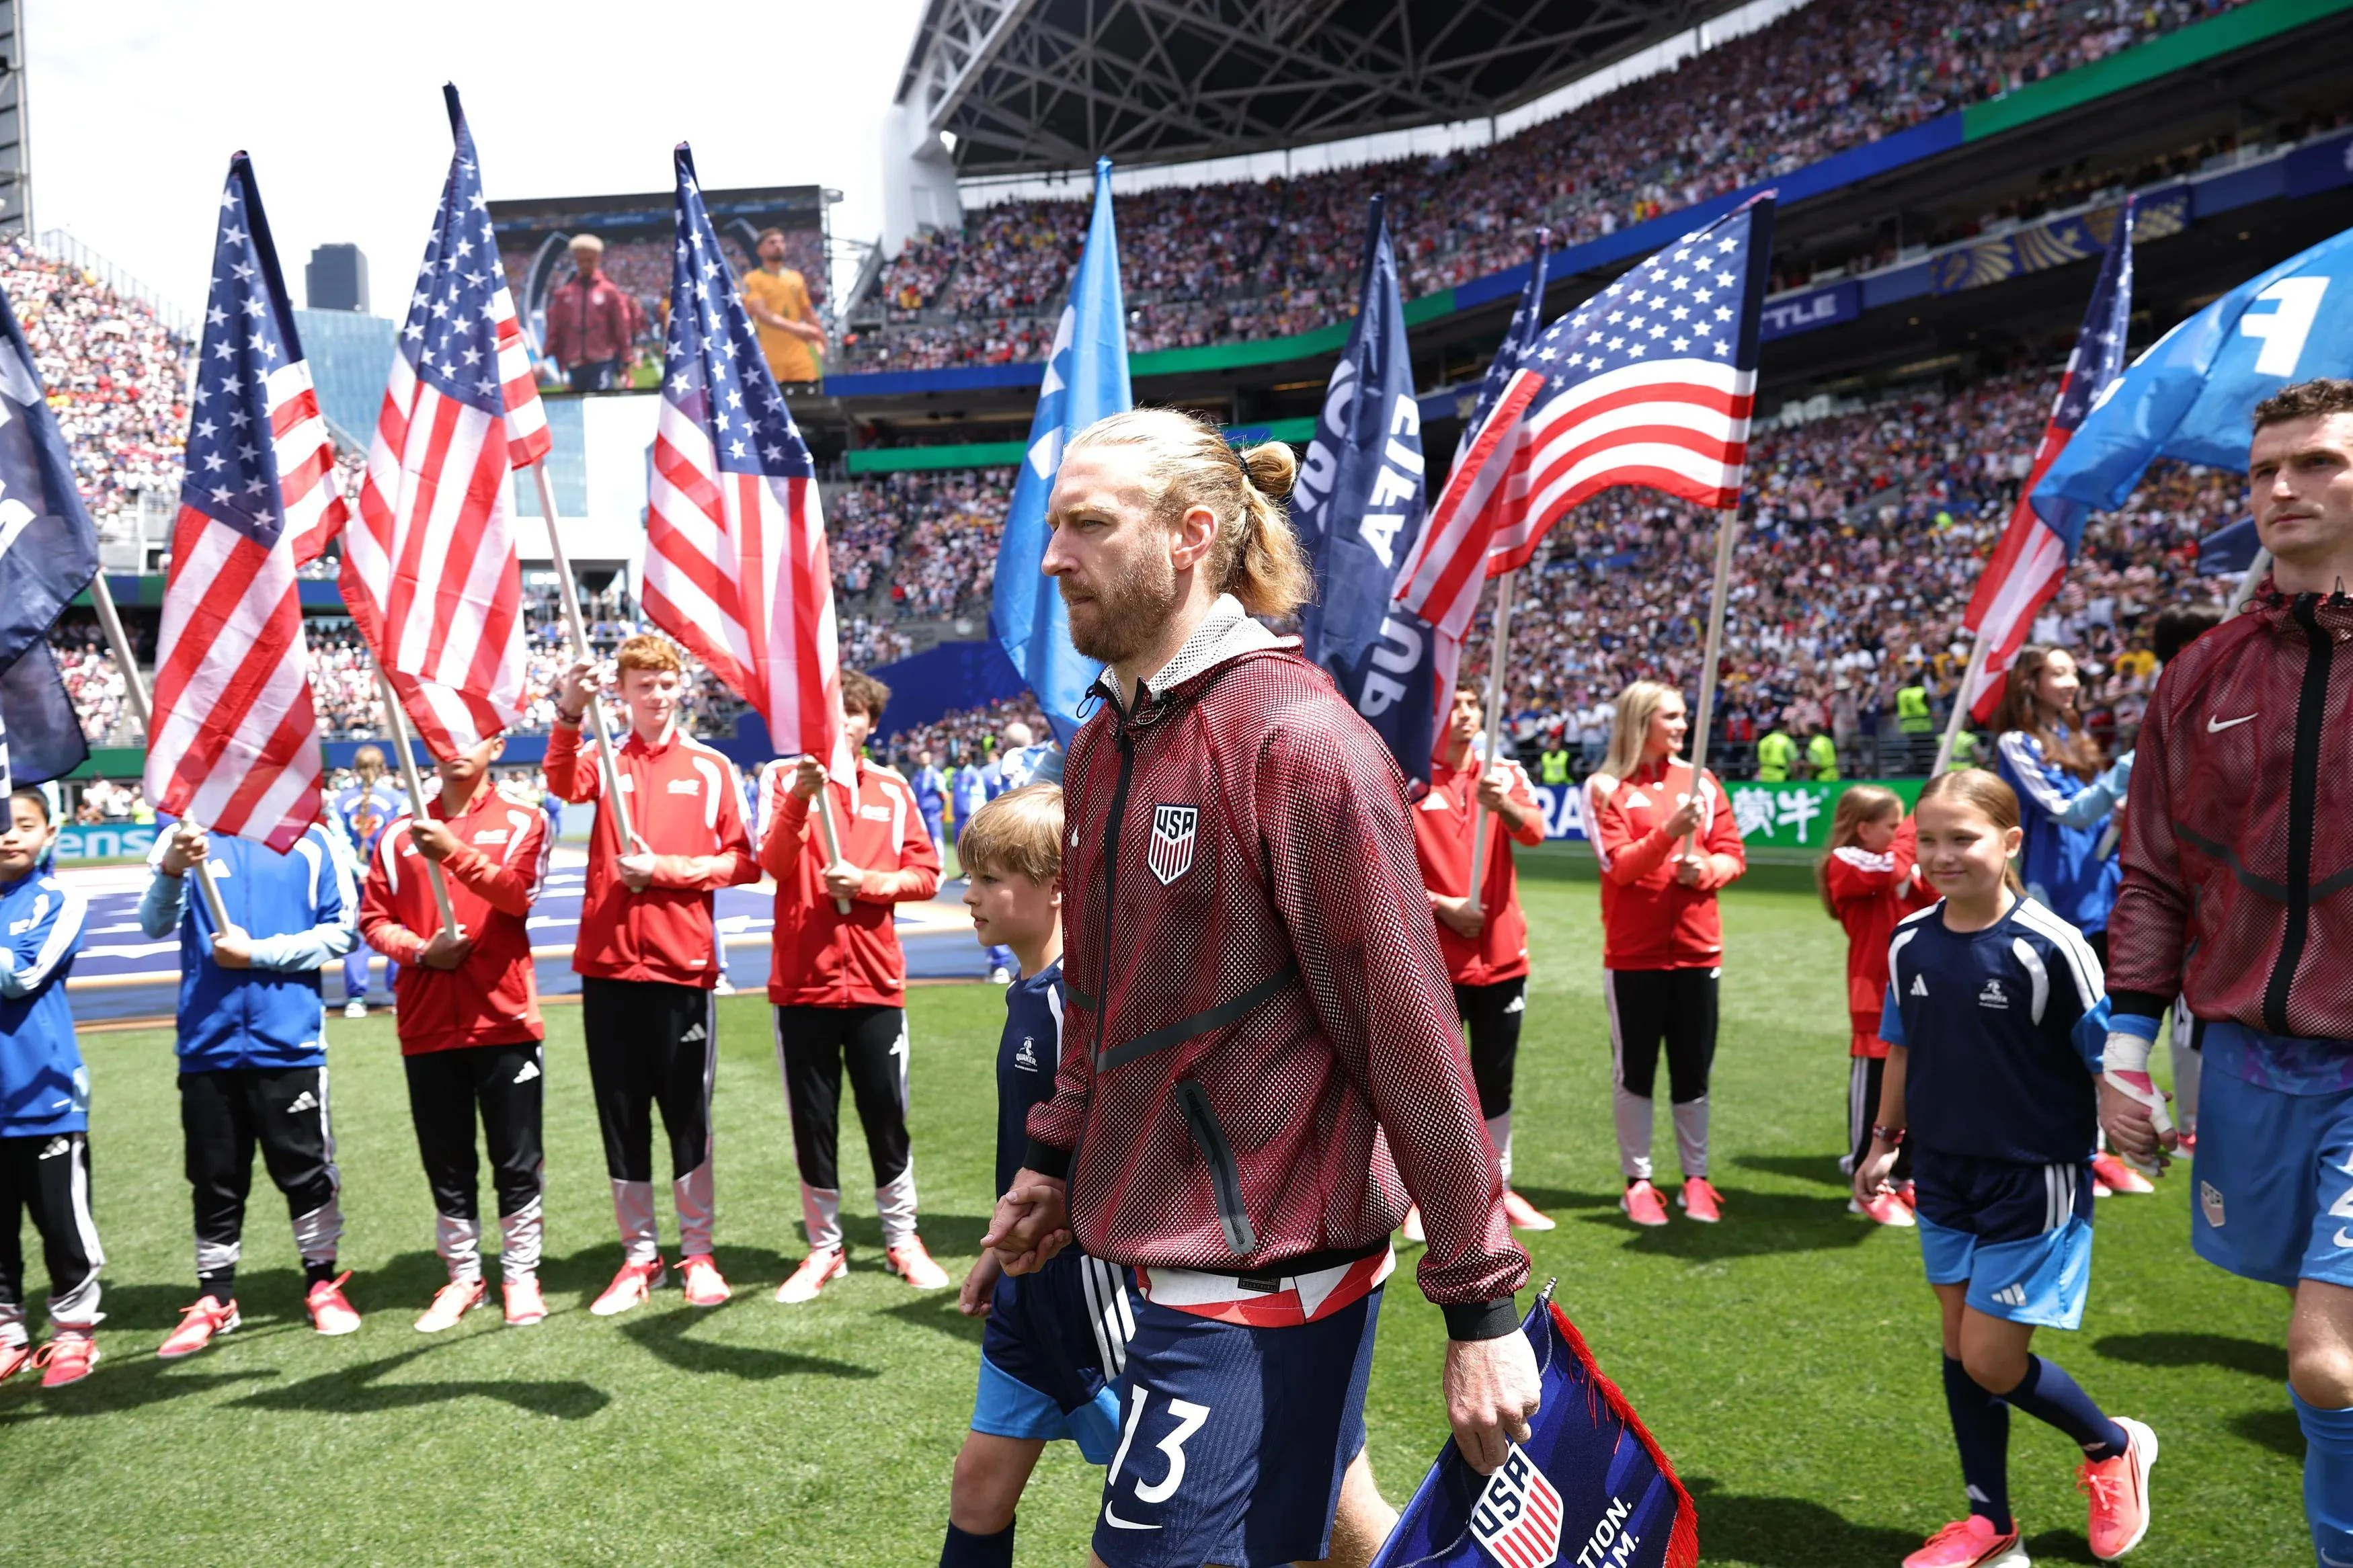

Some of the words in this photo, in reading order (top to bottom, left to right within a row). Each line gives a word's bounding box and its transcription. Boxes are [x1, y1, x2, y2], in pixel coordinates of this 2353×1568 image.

[1156, 809, 1195, 840] USA
[1016, 1053, 1036, 1066] QUAKER
[1108, 1383, 1211, 1503] 13
[1472, 1450, 1529, 1538] USA
